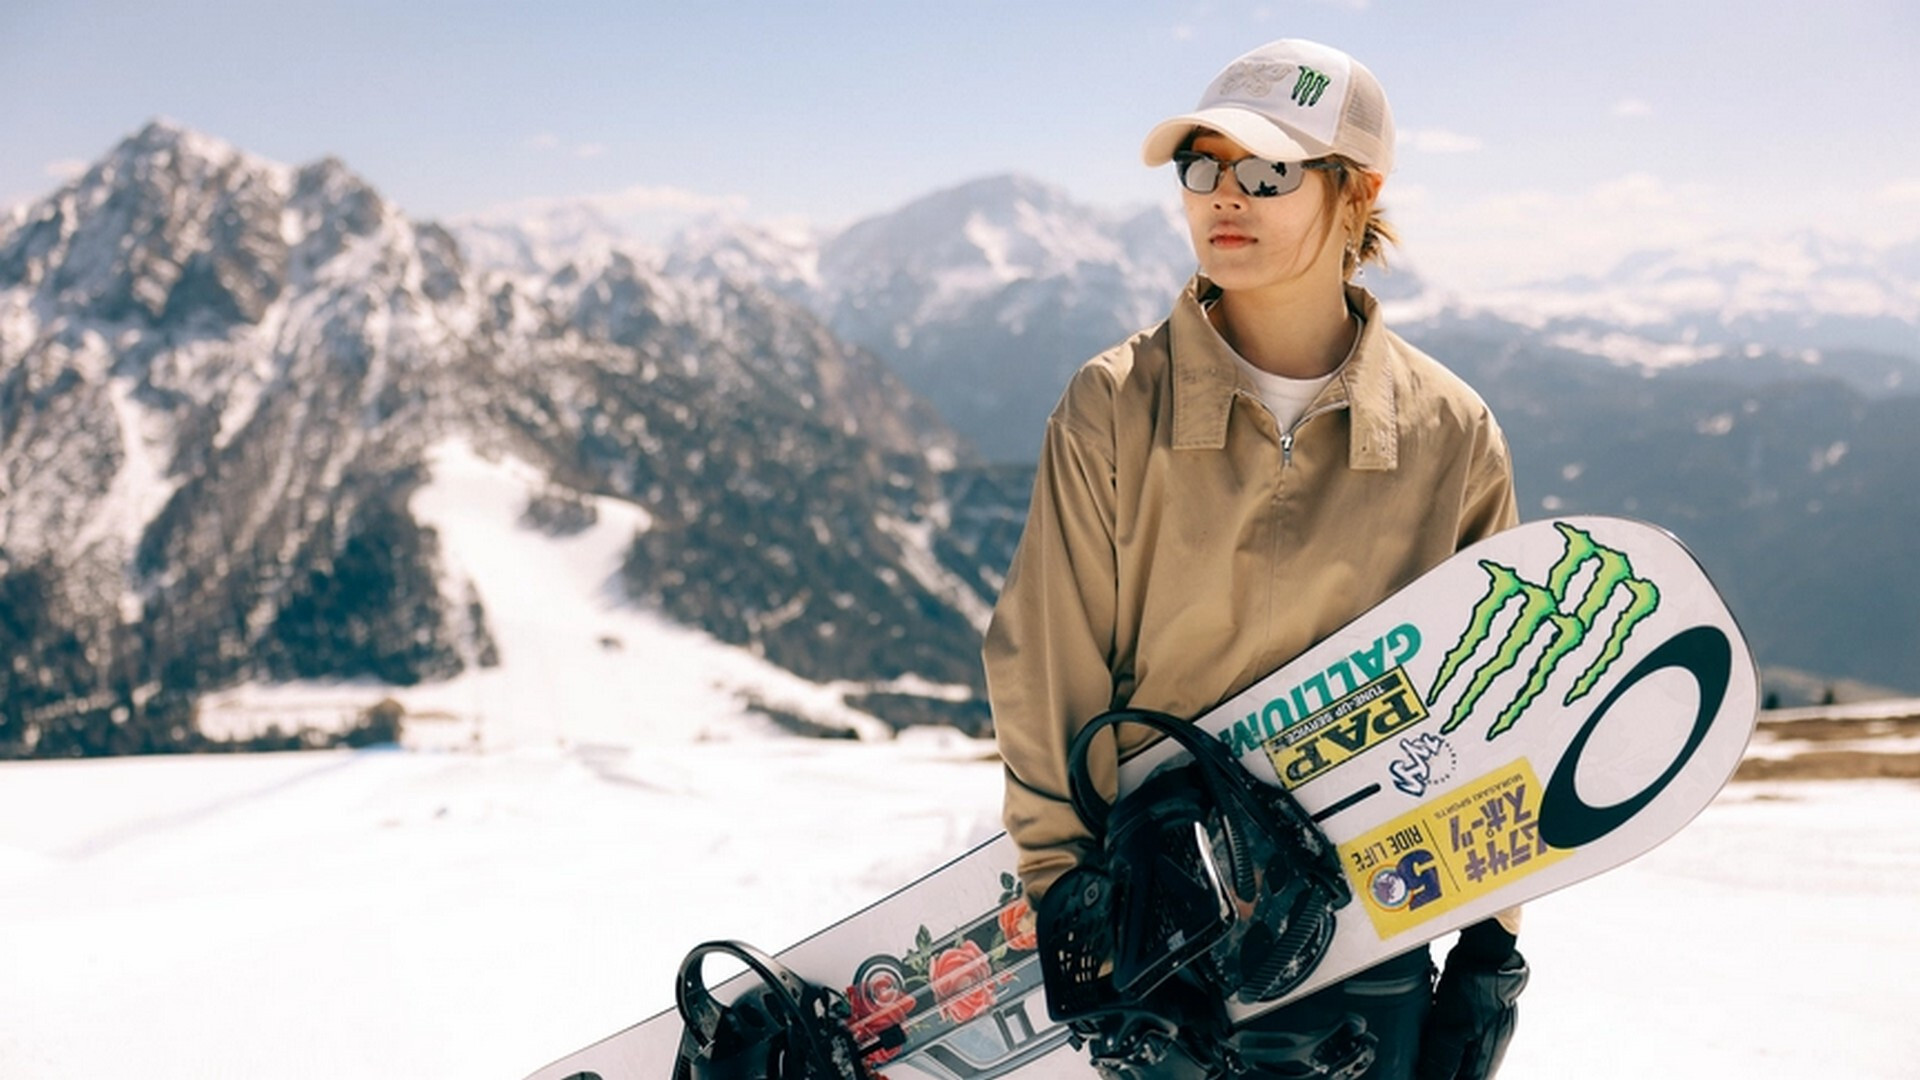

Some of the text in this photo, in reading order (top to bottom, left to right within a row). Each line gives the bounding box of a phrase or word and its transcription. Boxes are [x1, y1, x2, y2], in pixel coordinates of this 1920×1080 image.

[1218, 623, 1422, 759] GALLIUM
[1335, 683, 1386, 717] TUNE-UP
[1286, 689, 1420, 782] PAP
[1351, 824, 1424, 873] RIDE LIFE
[1449, 784, 1532, 853] スポーツ
